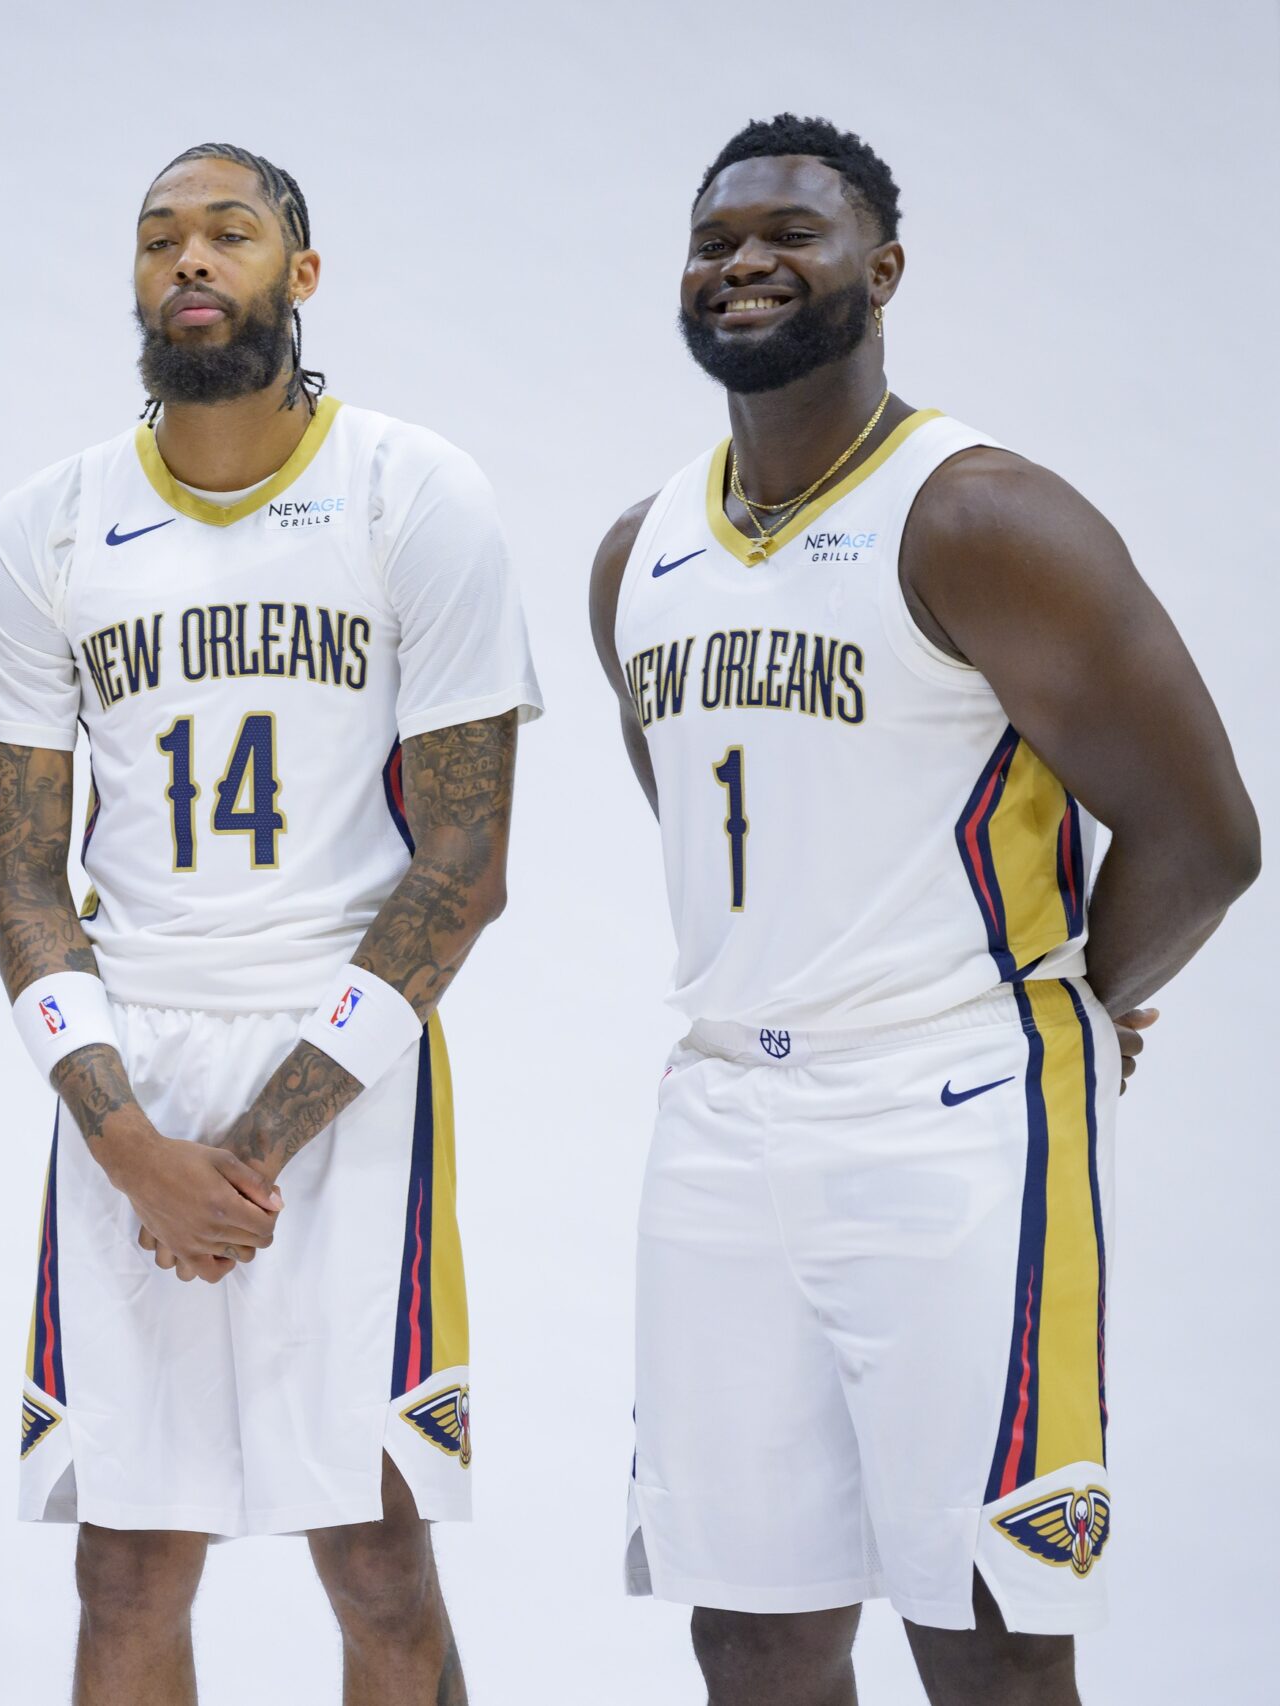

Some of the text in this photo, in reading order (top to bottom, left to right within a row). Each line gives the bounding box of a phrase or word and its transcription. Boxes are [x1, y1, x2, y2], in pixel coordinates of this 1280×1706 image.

[269, 497, 346, 517] NEWAGE
[280, 515, 331, 528] GRILLS
[804, 532, 878, 550] NEWAGE
[811, 551, 860, 563] GRILLS
[81, 601, 371, 714] NEW ORLEANS
[701, 627, 867, 726] ORLEANS
[156, 710, 287, 873] 14
[711, 744, 751, 913] 1
